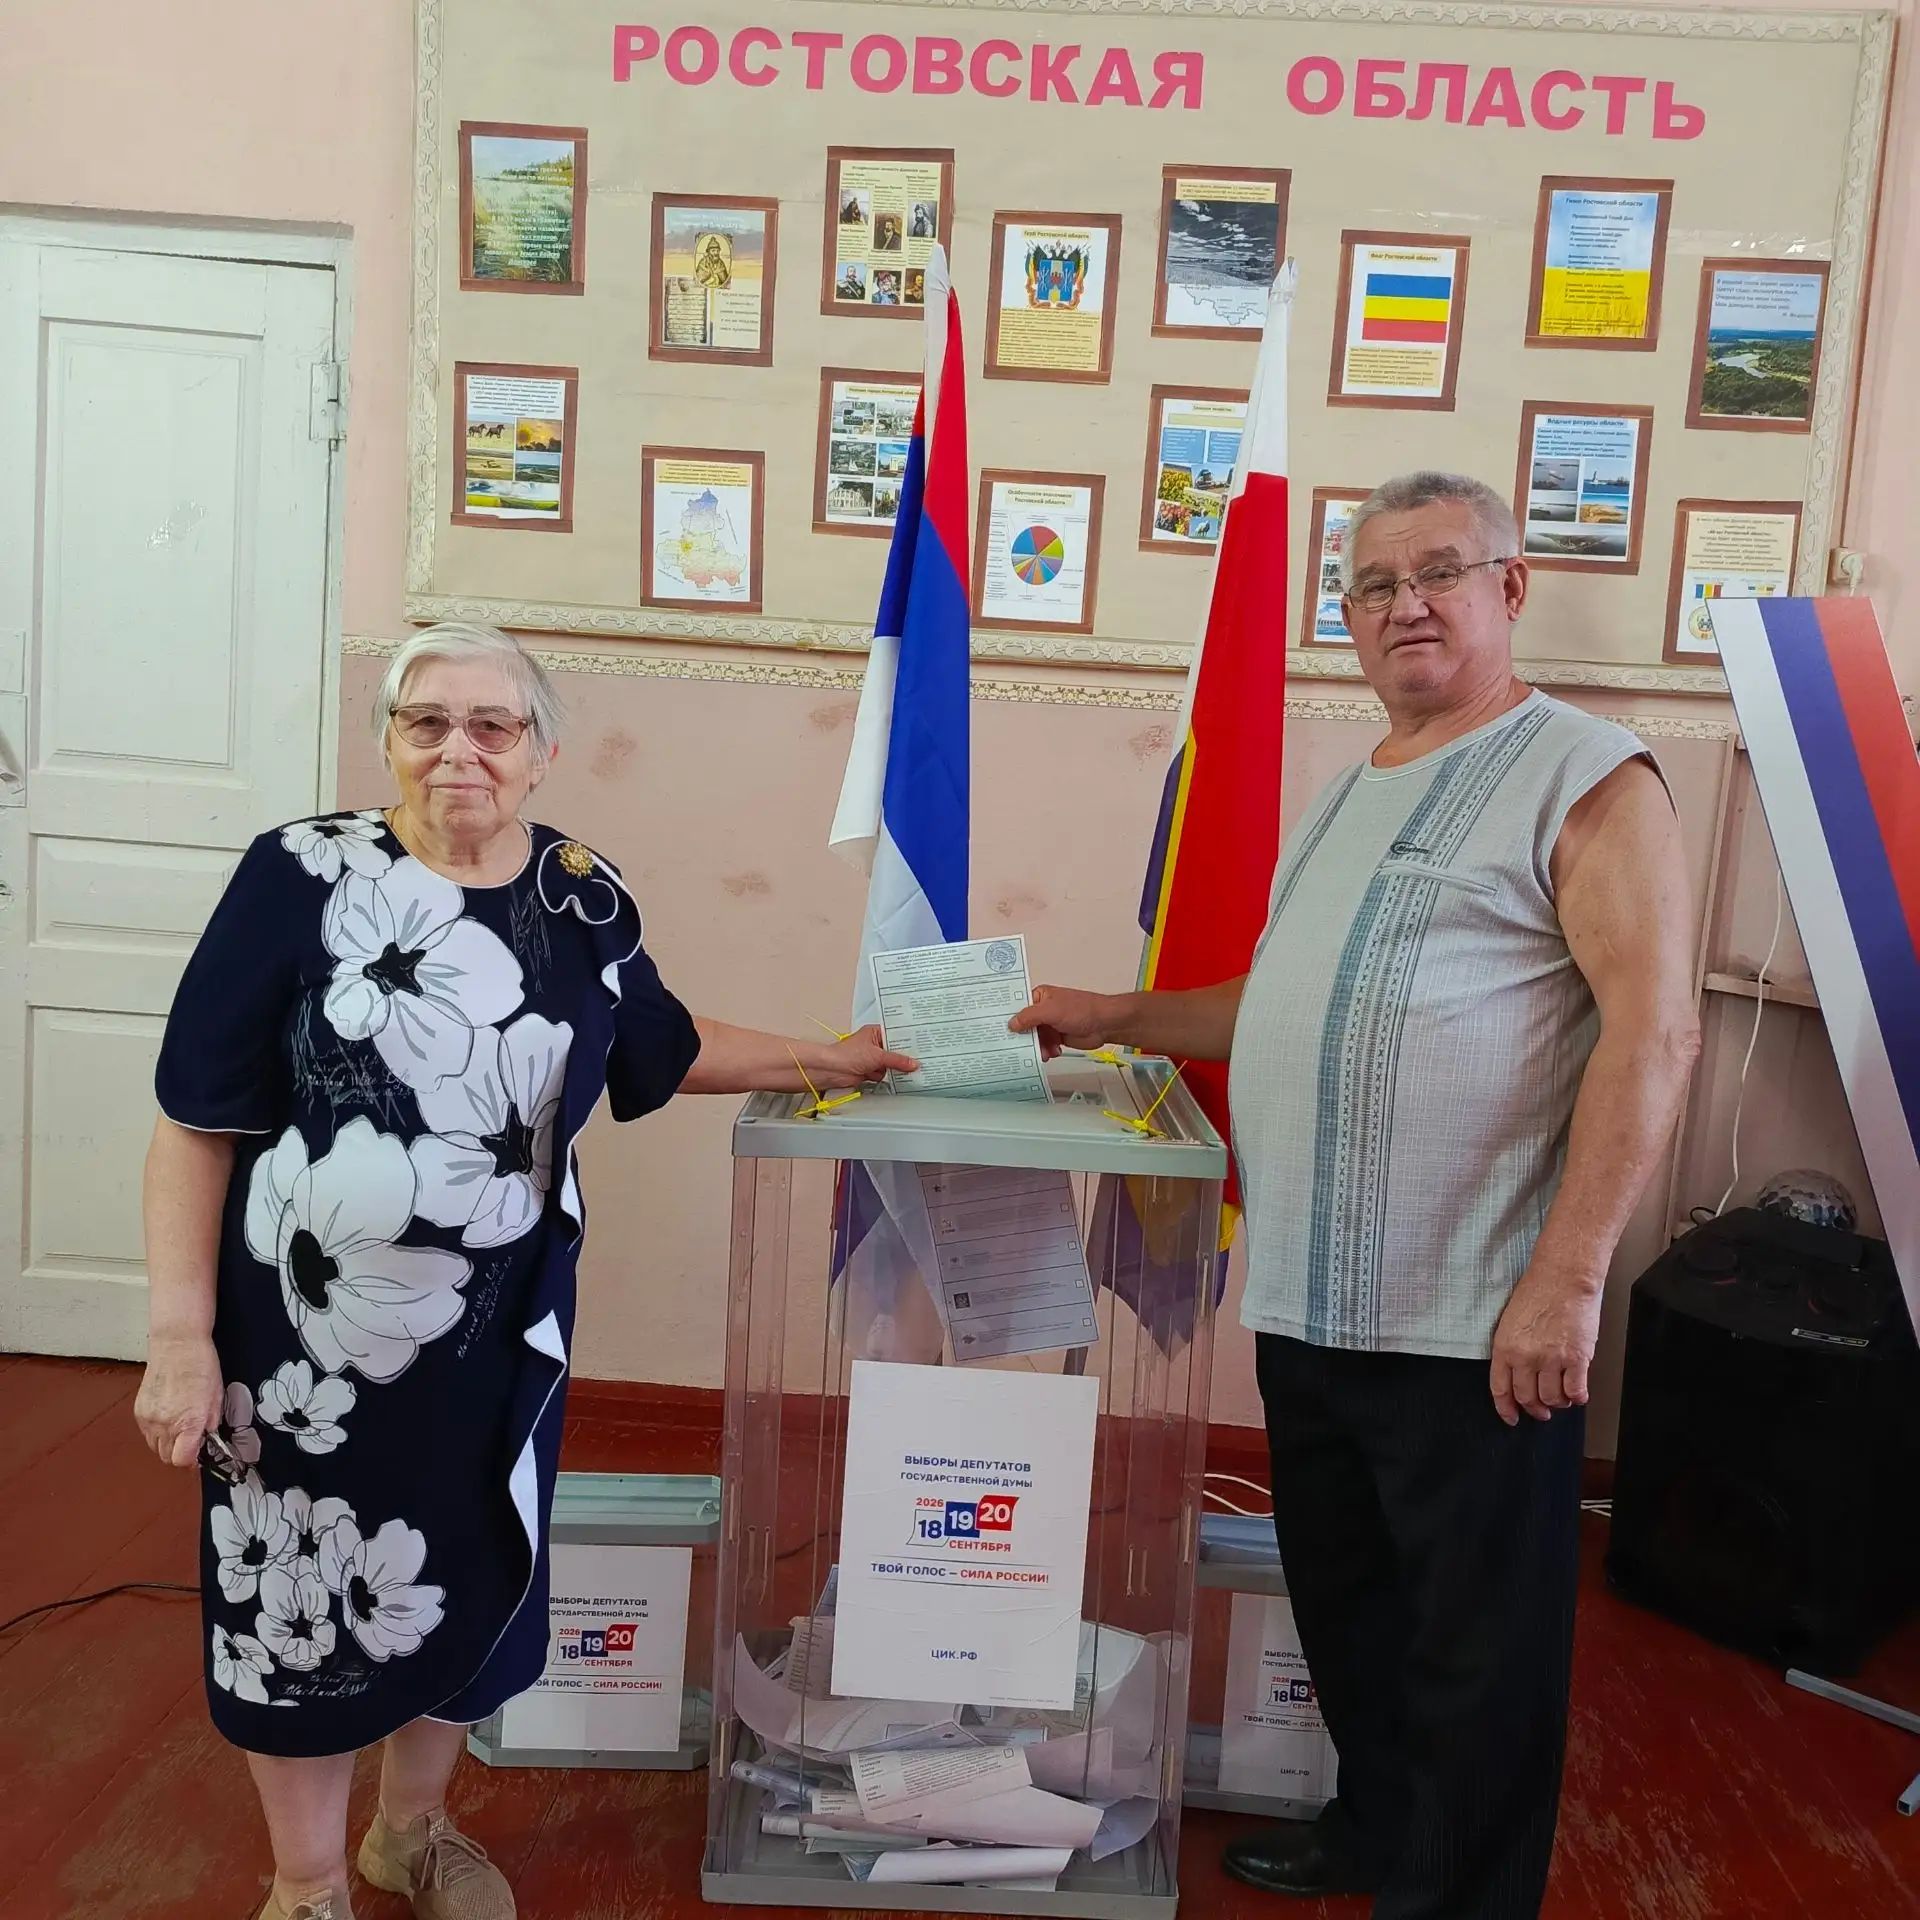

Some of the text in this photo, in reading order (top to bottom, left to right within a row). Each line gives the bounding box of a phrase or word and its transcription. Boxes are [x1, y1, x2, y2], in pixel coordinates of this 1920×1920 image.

[612, 25, 1706, 141] РОСТОВСКАЯ ОБЛАСТЬ
[1547, 418, 1571, 426] Водные
[1572, 419, 1598, 427] ресурсы
[904, 1455, 1031, 1472] ВЫБОРЫ ДЕПУТАТОВ
[900, 1472, 1033, 1488] ГОСУДАРСТВЕННОЙ ДУМЫ
[916, 1497, 944, 1508] 2026
[918, 1502, 1011, 1539] 18 19 20
[949, 1540, 1012, 1553] СЕНТЯБРЯ
[871, 1562, 903, 1574] ТВОЙ
[905, 1565, 946, 1577] ГОЛОС
[960, 1569, 993, 1580] СИЛА
[996, 1572, 1050, 1584] РОССИИ!
[549, 1596, 648, 1607] ВЫБОРЫ ДЕПУТАТОВ
[550, 1609, 624, 1617] ОСУДАРСТВЕННОЙ
[559, 1628, 581, 1636] 2026
[560, 1630, 632, 1660] 18 19 20
[931, 1650, 978, 1661] ЦИК.РФ
[1264, 1650, 1299, 1659] ВЫБОРЫ
[584, 1659, 633, 1667] СЕНТЯБРЯ
[535, 1678, 550, 1687] ОЙ
[551, 1680, 583, 1688] ГОЛОС
[593, 1681, 619, 1689] СИЛА
[621, 1682, 662, 1690] РОССИИ!
[1273, 1685, 1309, 1703] 18 19
[1244, 1714, 1264, 1722] ТВОЙ
[1265, 1717, 1291, 1726] ГОЛОС
[1280, 1767, 1310, 1777] ЦИК.РФ
